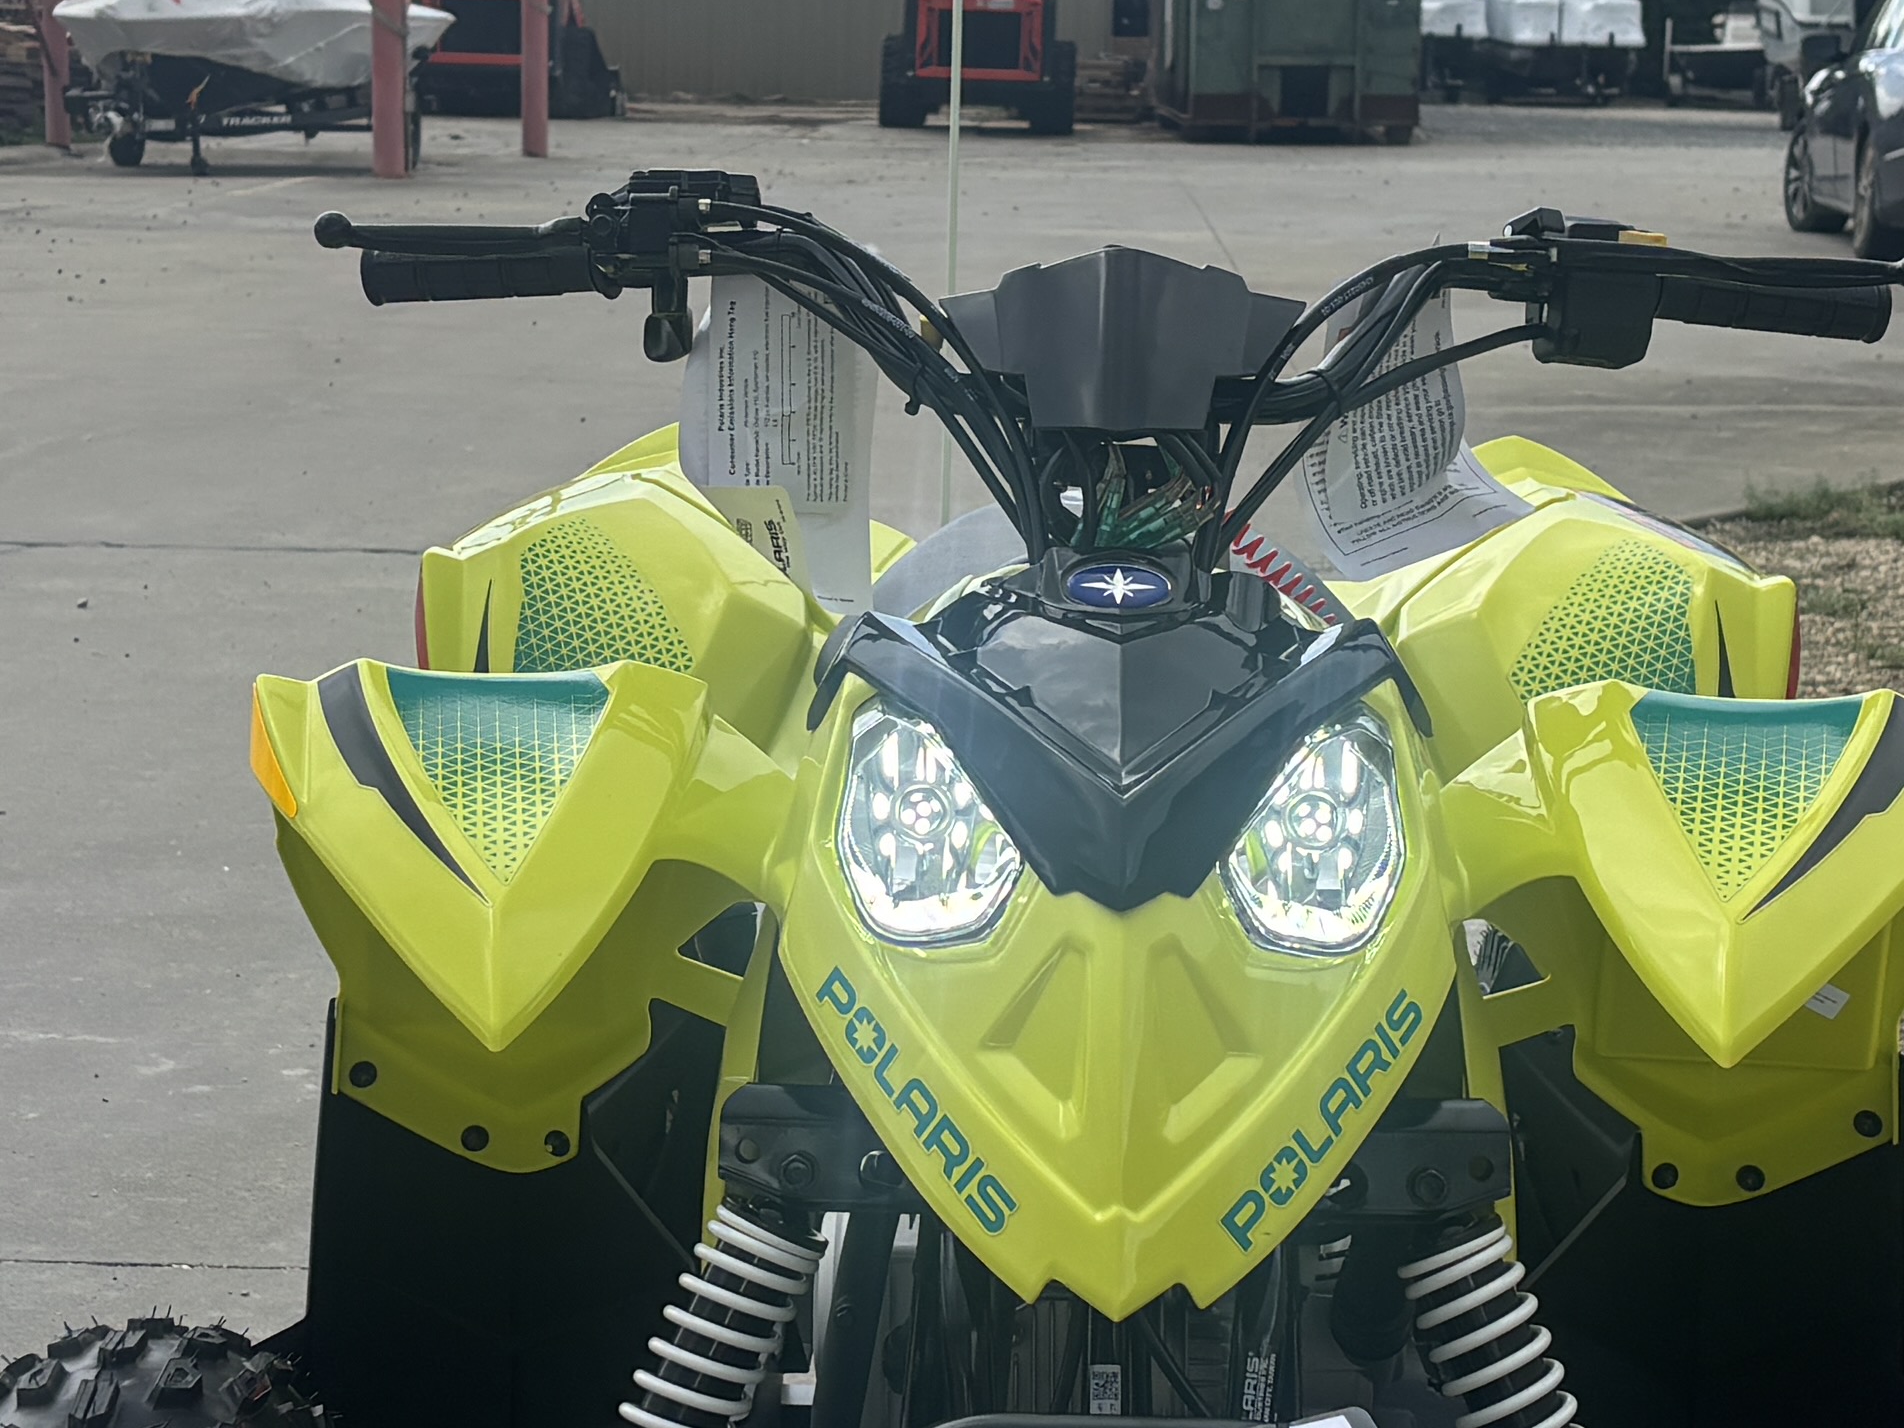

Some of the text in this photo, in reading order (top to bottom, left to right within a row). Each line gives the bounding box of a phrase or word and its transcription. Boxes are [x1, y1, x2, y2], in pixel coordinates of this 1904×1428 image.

[222, 114, 293, 127] TRACKER
[764, 519, 787, 573] LARIS
[816, 965, 1018, 1234] POLARIS
[1220, 988, 1423, 1253] POLARIS
